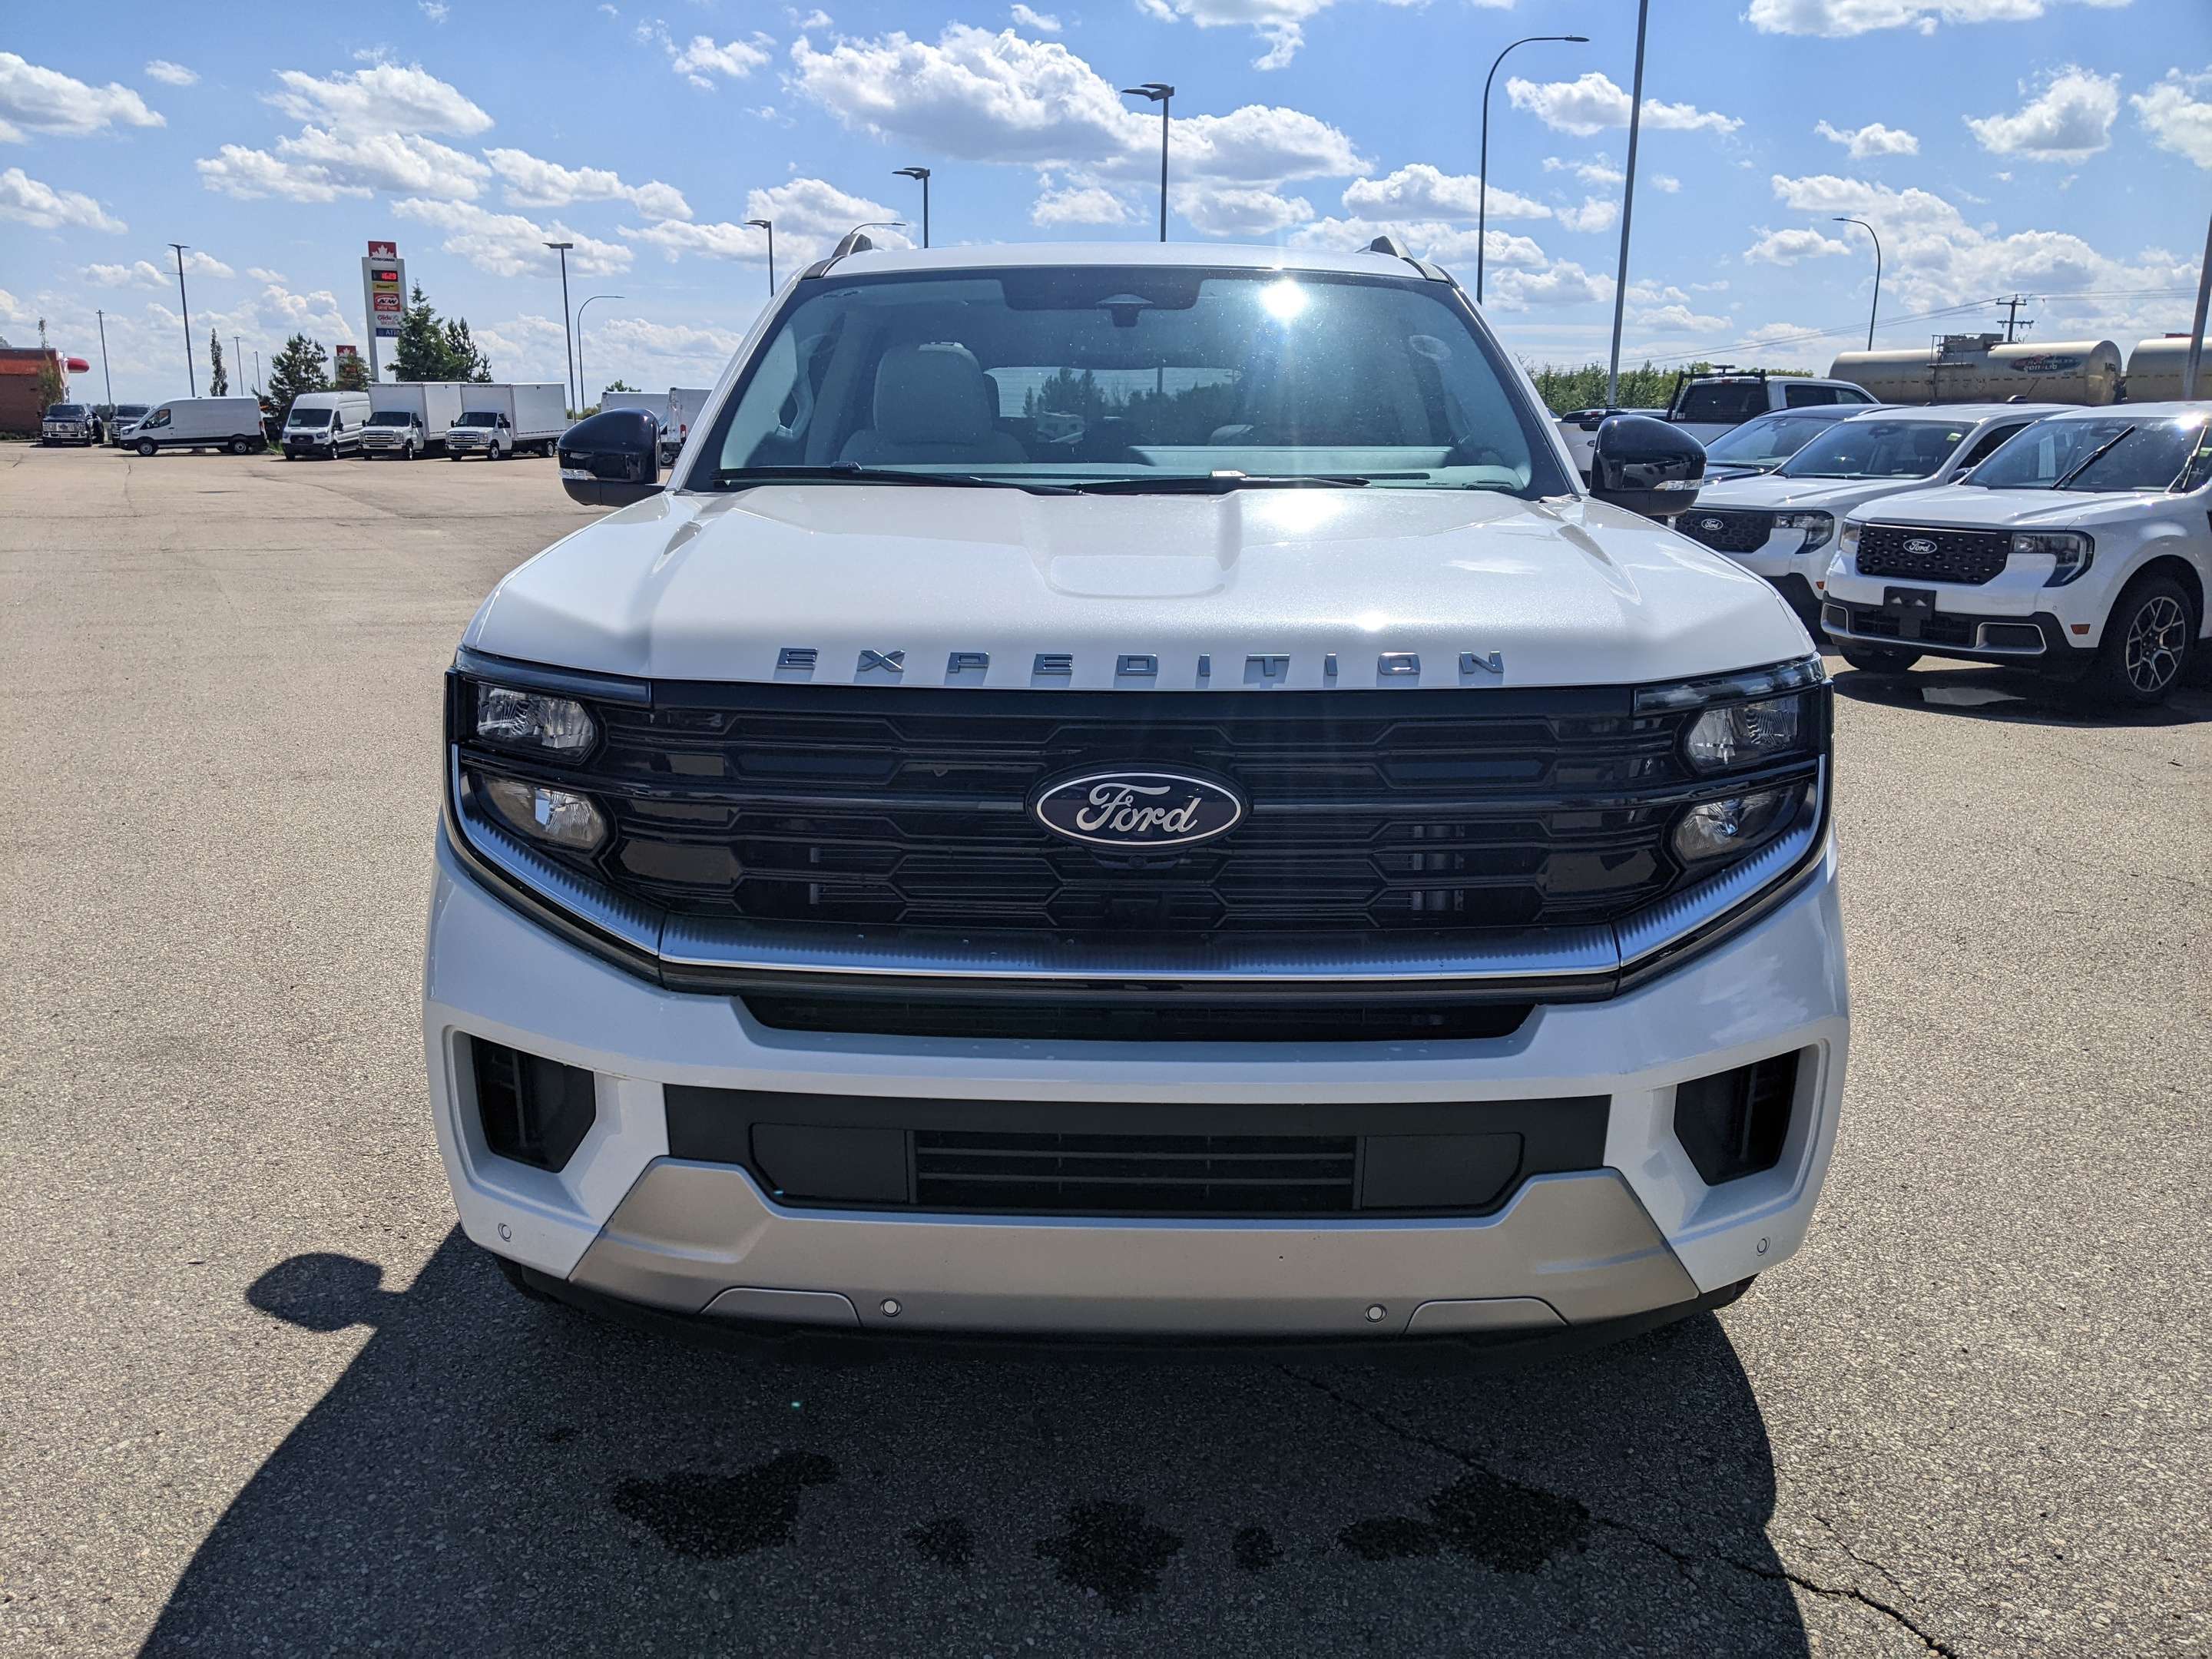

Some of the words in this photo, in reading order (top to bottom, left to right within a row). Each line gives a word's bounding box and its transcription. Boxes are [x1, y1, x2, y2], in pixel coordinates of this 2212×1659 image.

[1704, 519, 1720, 528] Ford
[1909, 541, 1931, 551] Ford
[777, 647, 1505, 676] EXPEDITION
[1076, 783, 1201, 833] Ford
